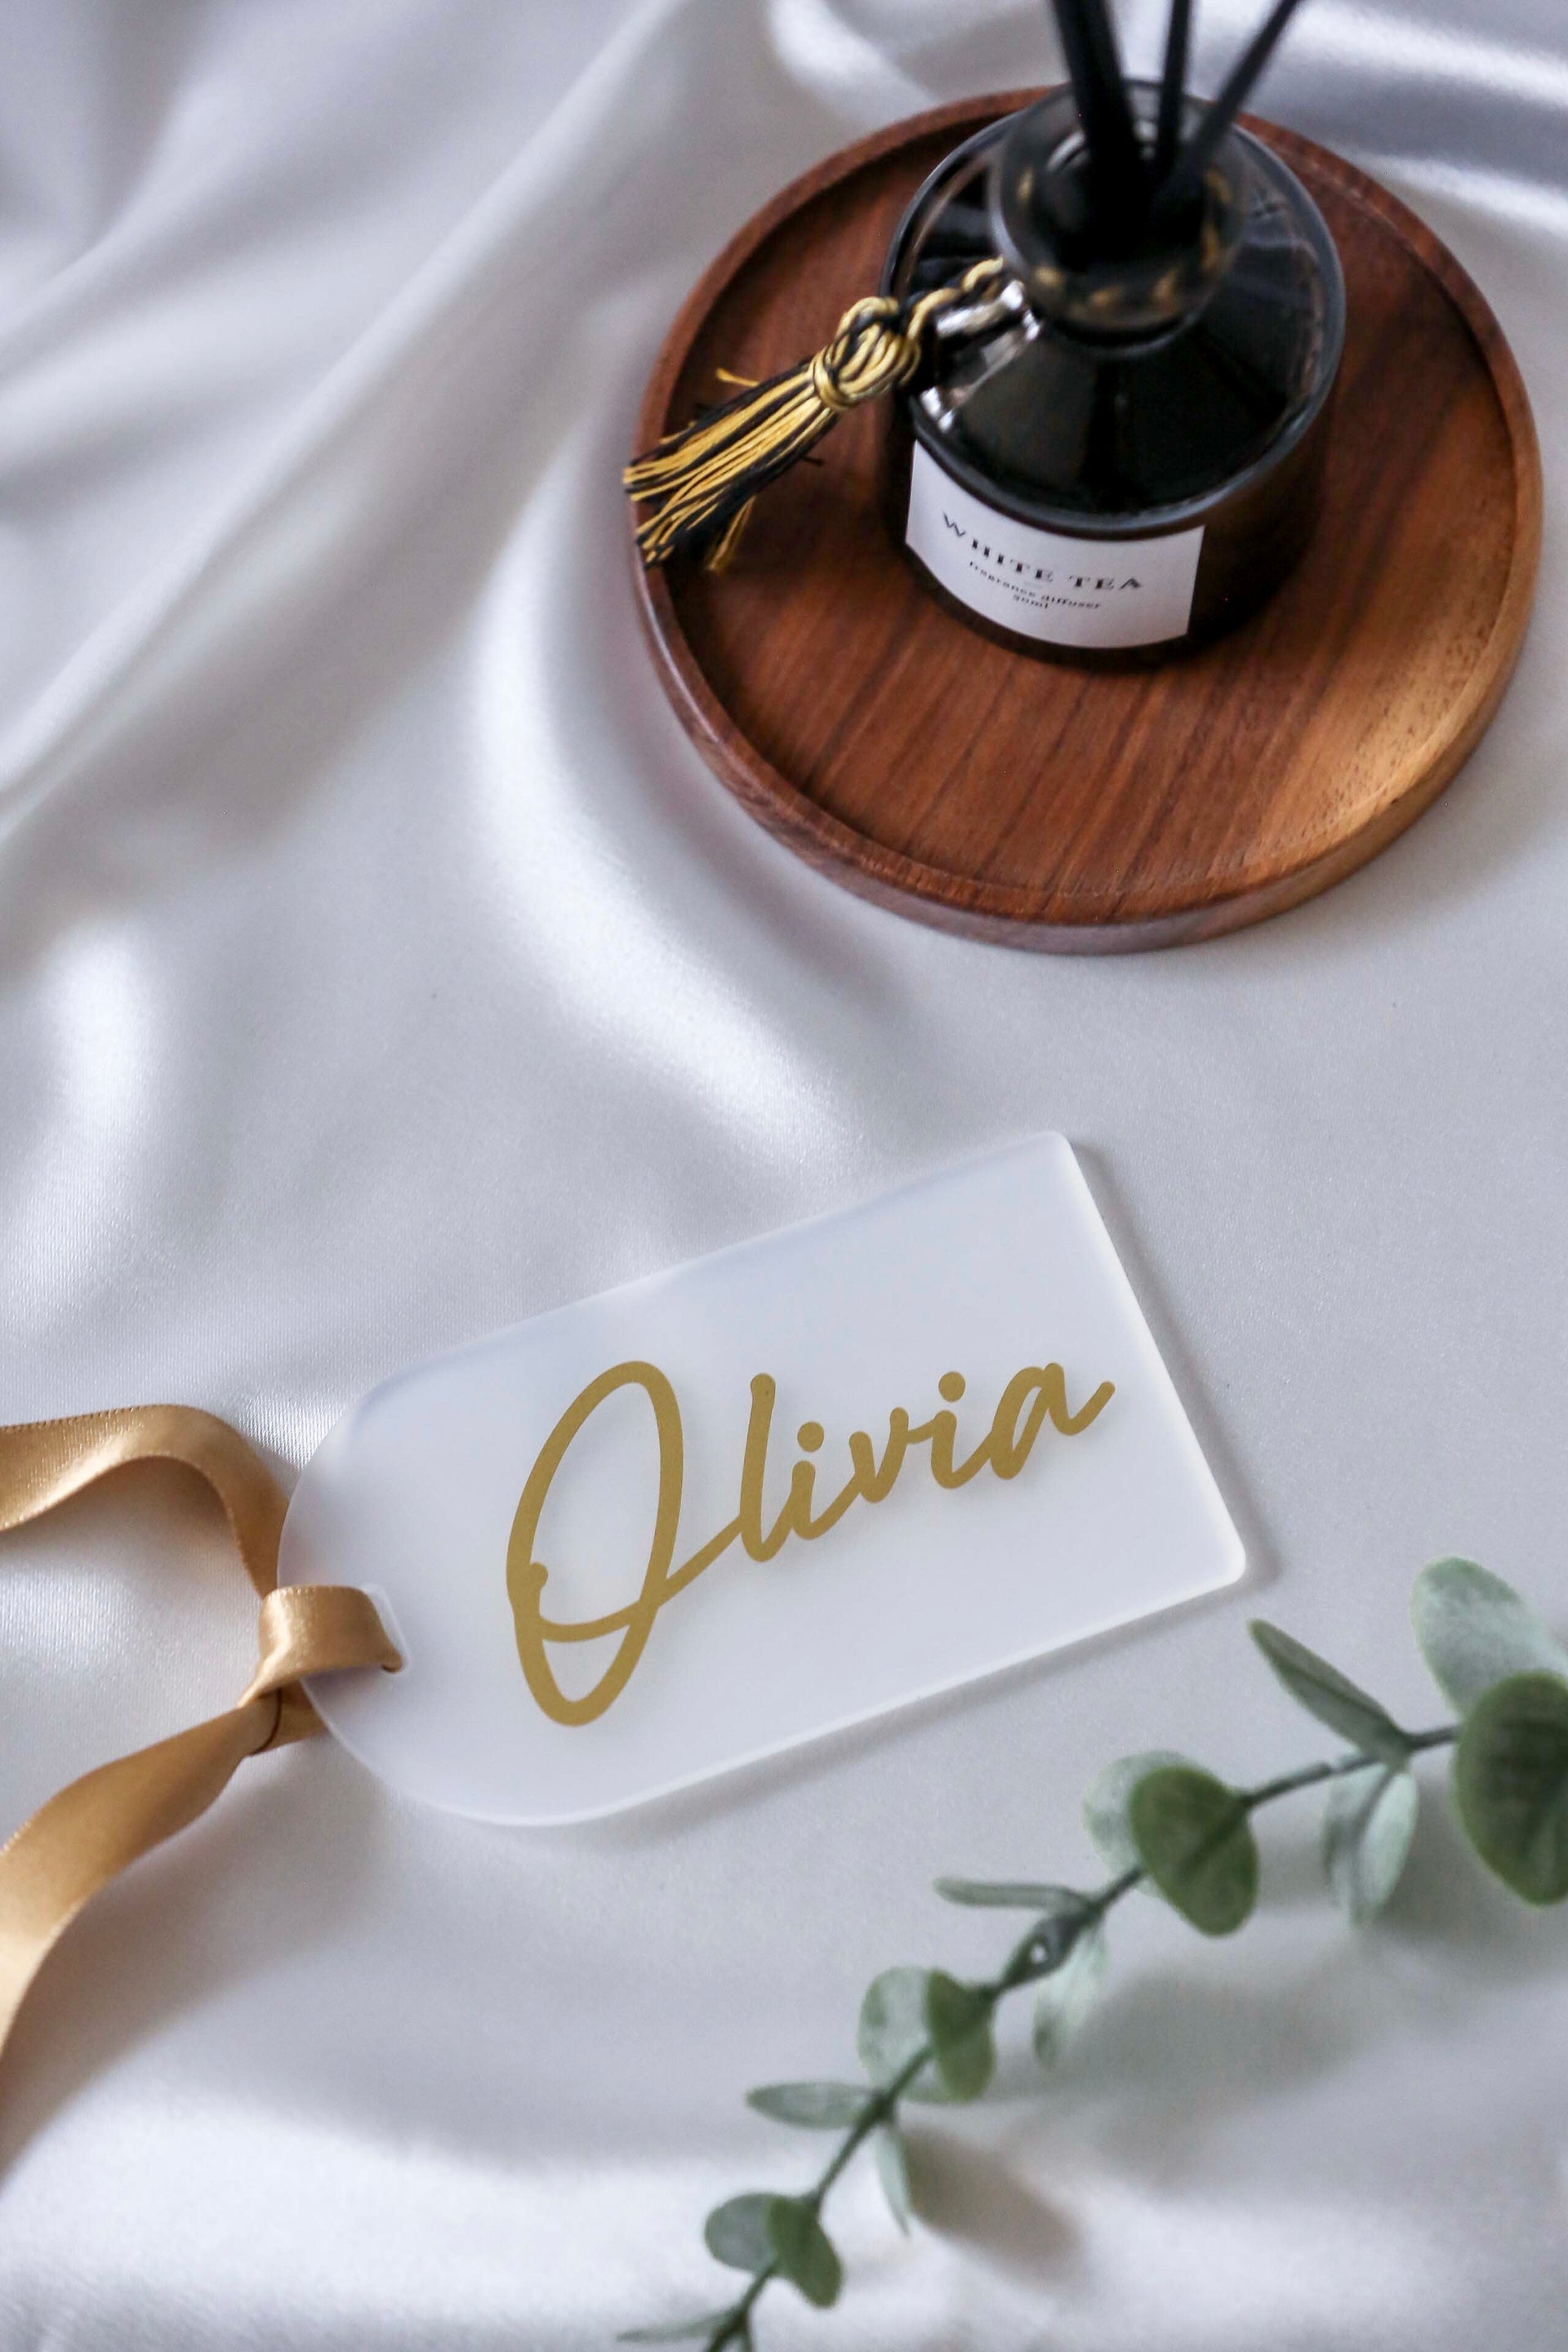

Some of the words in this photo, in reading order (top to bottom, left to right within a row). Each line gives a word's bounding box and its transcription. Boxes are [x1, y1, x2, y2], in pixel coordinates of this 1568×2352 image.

[943, 511, 1054, 582] WHITE
[1068, 574, 1142, 590] TEA
[1040, 595, 1101, 609] diffuser
[506, 1361, 1116, 1727] Olivia
